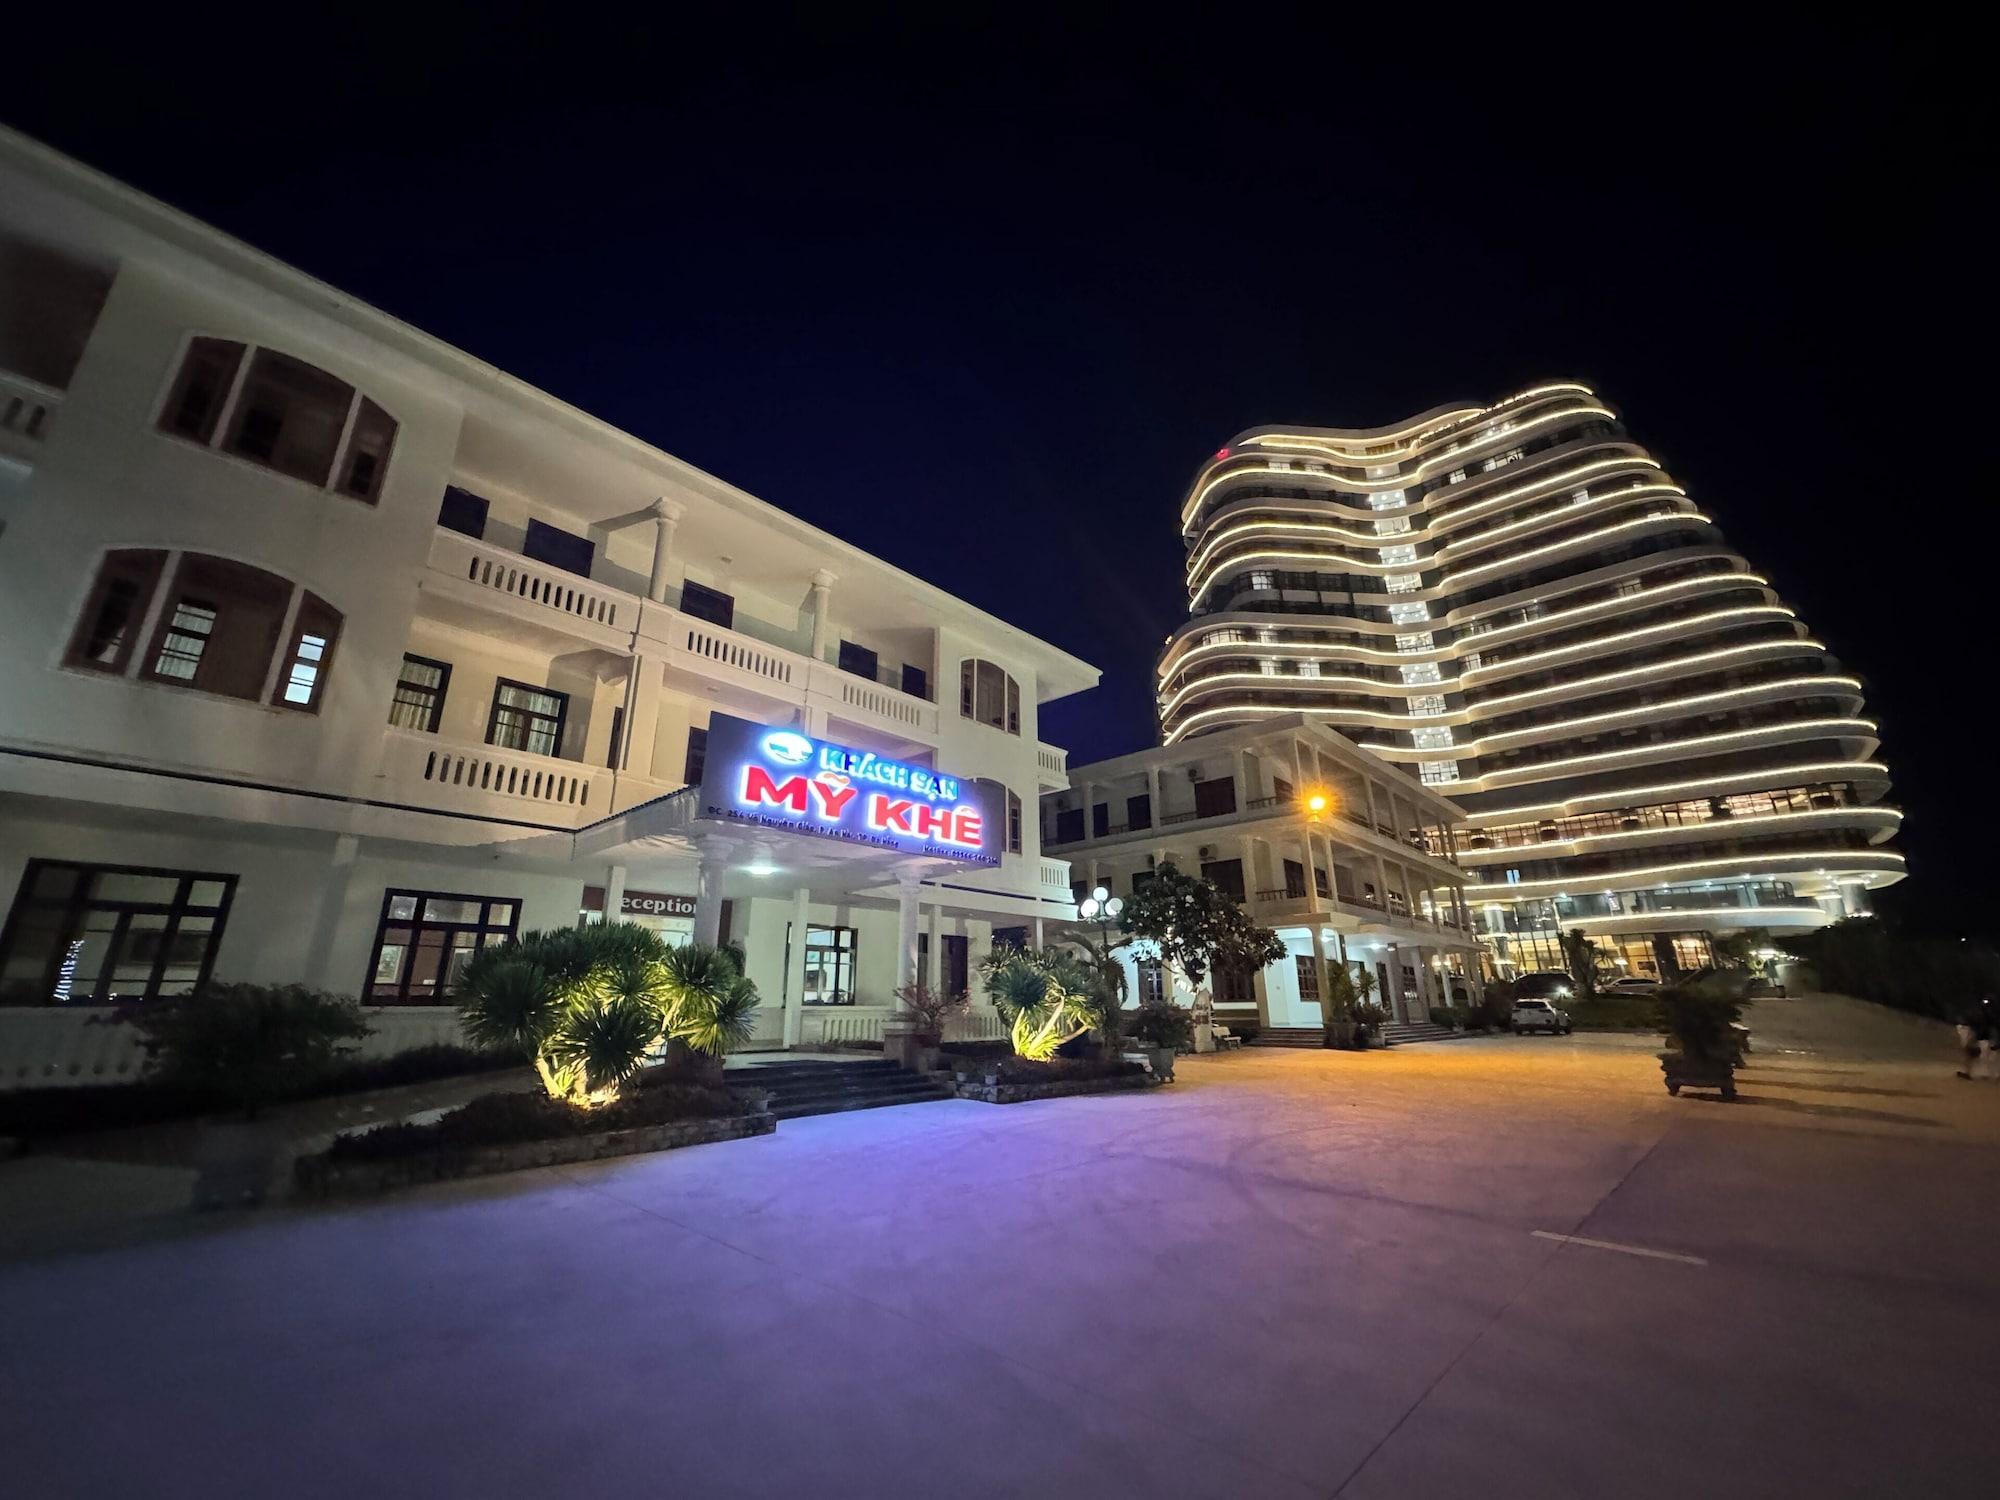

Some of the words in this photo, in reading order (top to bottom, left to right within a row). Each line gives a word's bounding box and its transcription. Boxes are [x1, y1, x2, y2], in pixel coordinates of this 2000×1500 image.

[820, 748, 908, 788] KHÁCH
[741, 765, 858, 819] MỸ
[868, 794, 982, 848] KHÊ
[621, 897, 697, 914] eceptio
